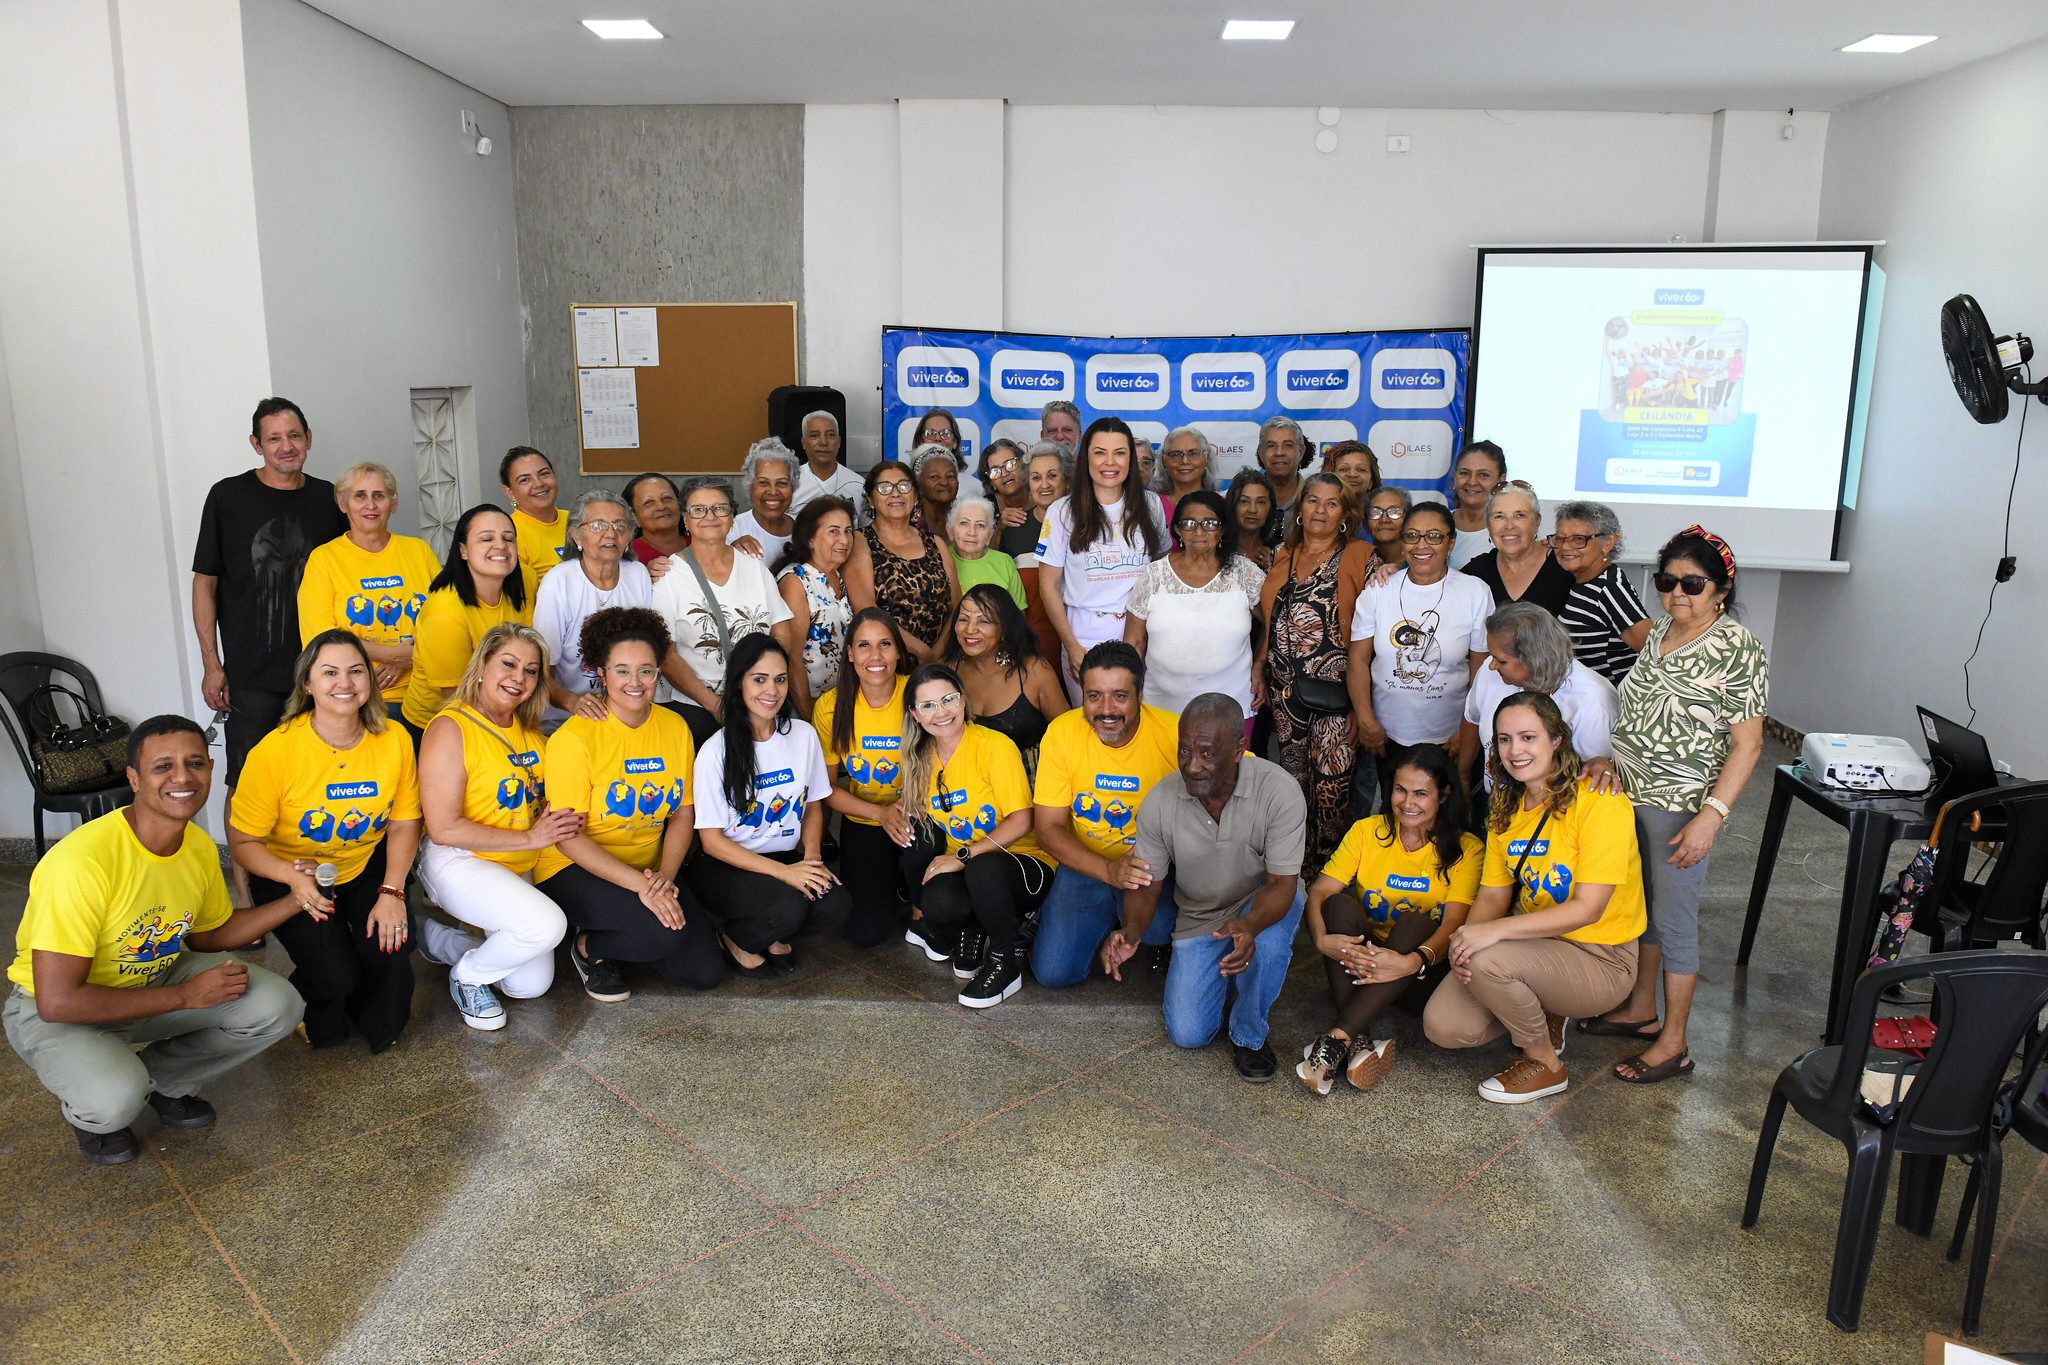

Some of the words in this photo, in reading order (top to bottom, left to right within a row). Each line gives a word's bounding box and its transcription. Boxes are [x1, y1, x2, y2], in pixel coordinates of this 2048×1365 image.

[1640, 410, 1693, 421] CEILÂNDIA
[1219, 446, 1244, 454] ILAES
[1406, 444, 1432, 452] ILAES
[115, 905, 167, 943] MOVIMENTE-SE
[119, 963, 156, 975] Viver
